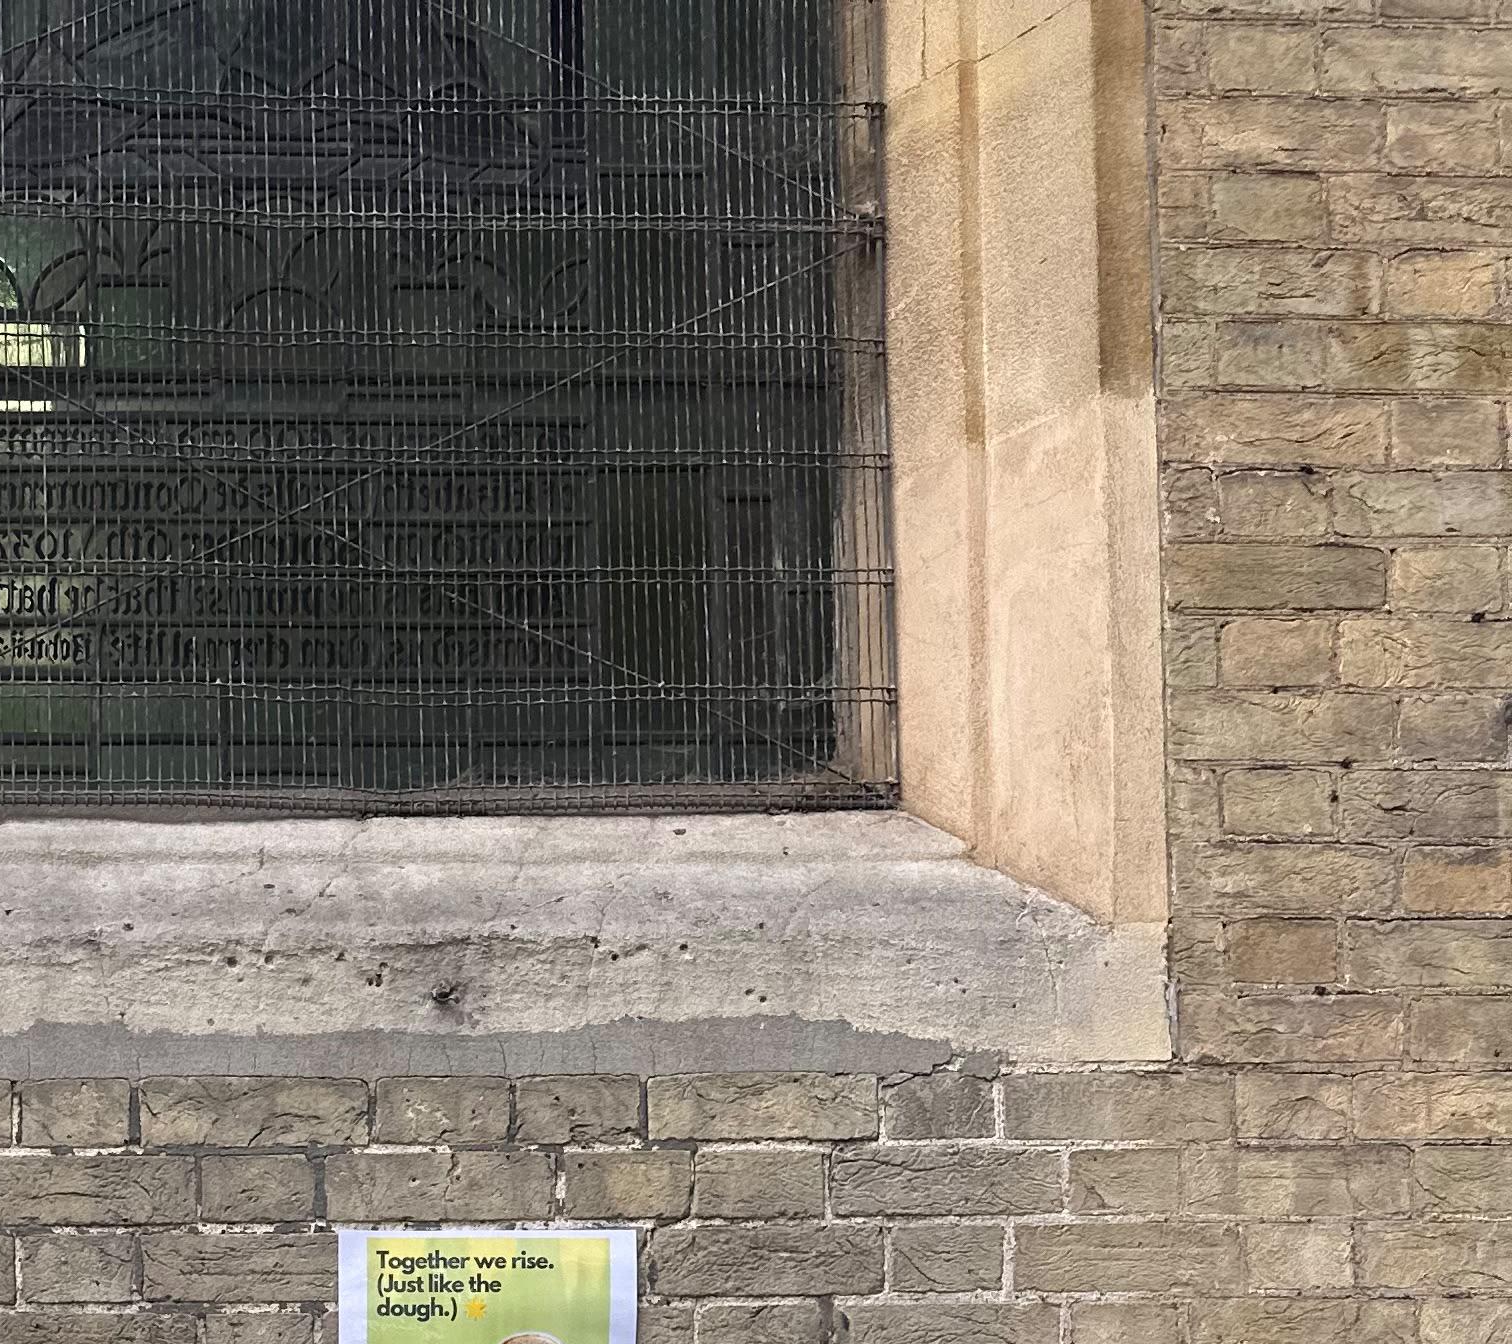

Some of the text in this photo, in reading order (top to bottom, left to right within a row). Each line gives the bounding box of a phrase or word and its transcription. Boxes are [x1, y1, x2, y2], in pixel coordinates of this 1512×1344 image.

[376, 1250, 554, 1274] Together we rise.
[376, 1274, 502, 1297] (Just like the
[376, 1297, 458, 1322] dough.)
